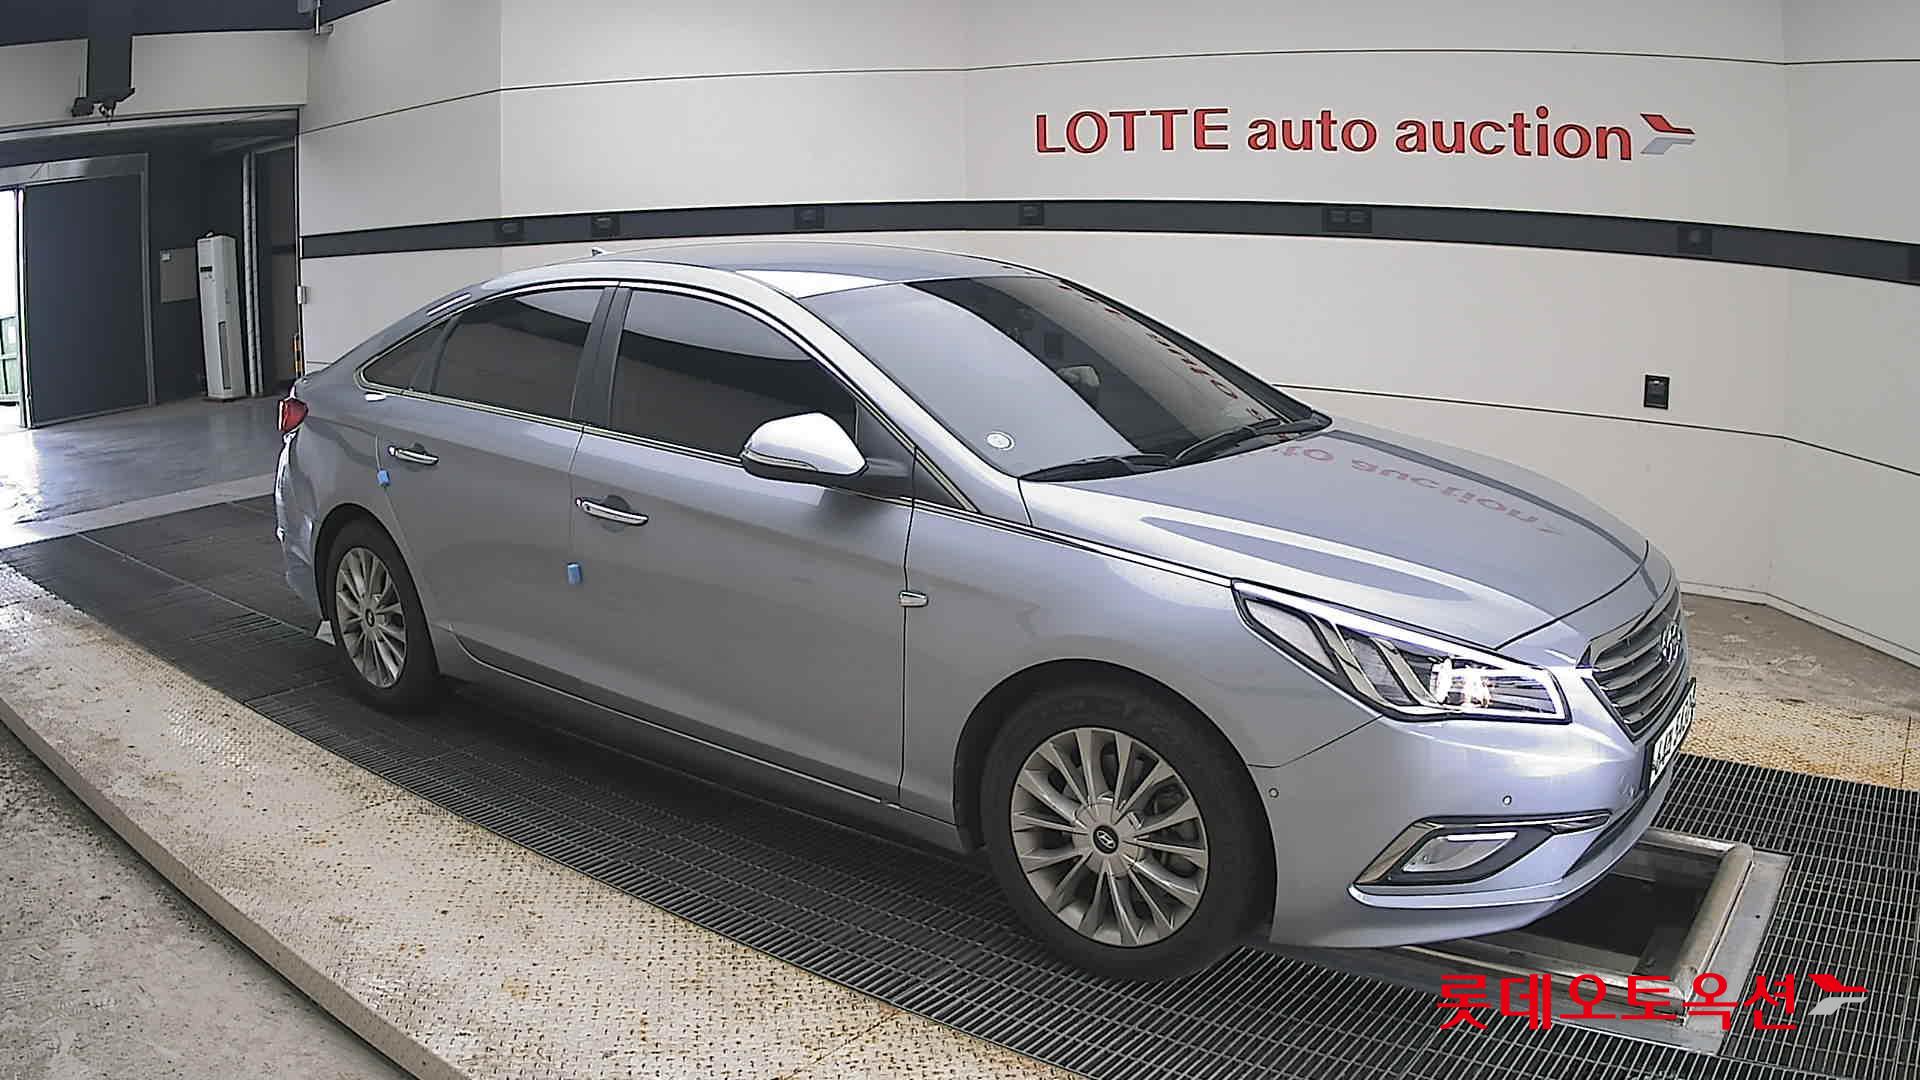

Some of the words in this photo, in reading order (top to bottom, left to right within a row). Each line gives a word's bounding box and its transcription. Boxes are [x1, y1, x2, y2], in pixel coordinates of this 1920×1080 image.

[1035, 108, 1229, 153] LOTTE
[1247, 110, 1377, 152] auto
[1395, 106, 1633, 160] auction
